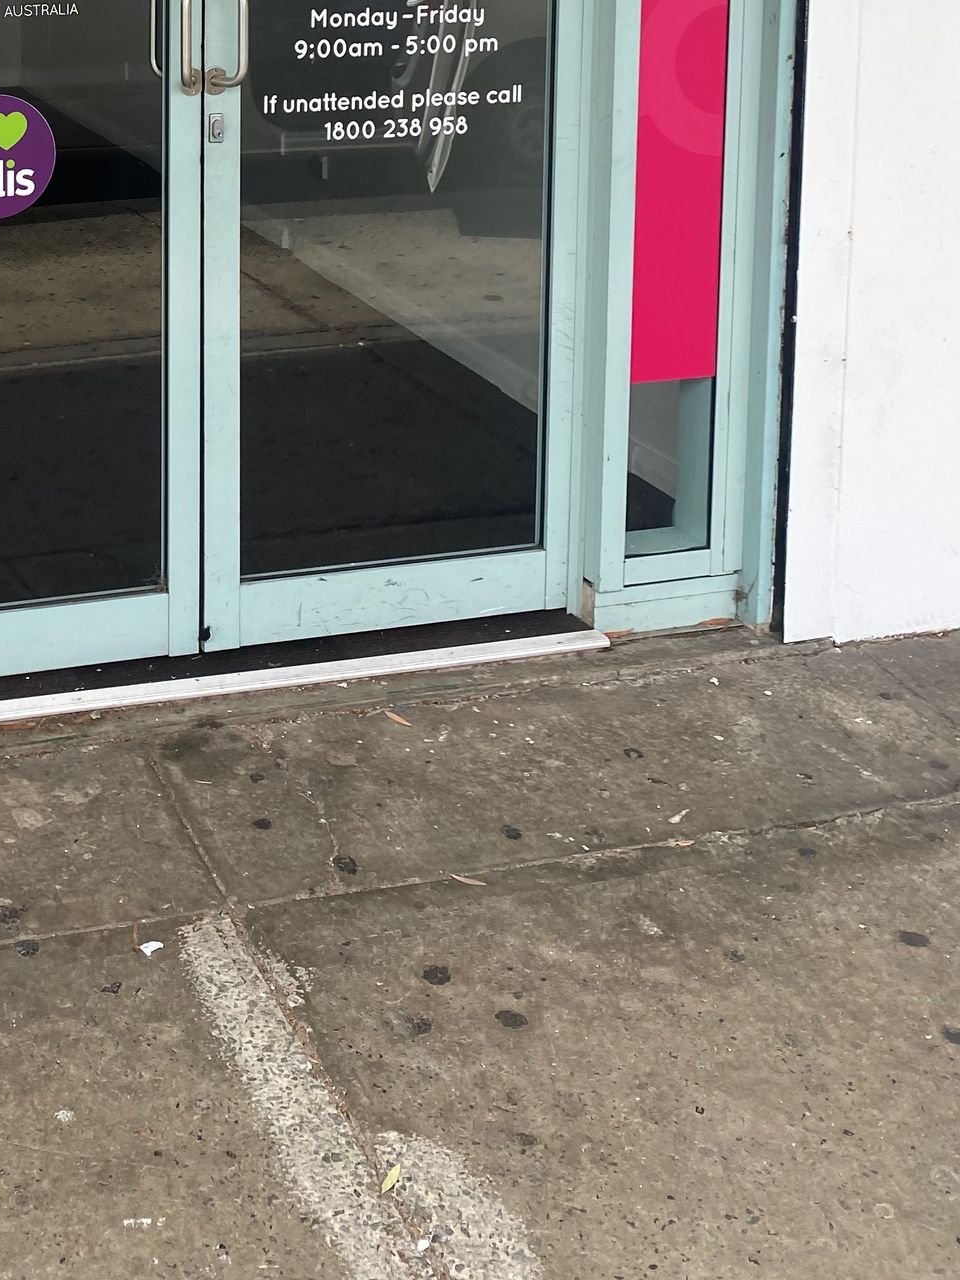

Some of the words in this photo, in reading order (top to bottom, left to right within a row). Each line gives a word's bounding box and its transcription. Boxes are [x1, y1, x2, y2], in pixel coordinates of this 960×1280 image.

[4, 3, 79, 18] AUSTRALIA
[294, 39, 383, 60] 9:00am
[405, 35, 457, 56] 5:00
[465, 36, 499, 57] pm
[263, 95, 278, 114] If
[283, 89, 404, 113] unattended
[412, 88, 480, 111] please
[487, 85, 522, 104] call
[324, 121, 376, 140] 1800
[383, 119, 422, 138] 238
[429, 116, 468, 136] 958
